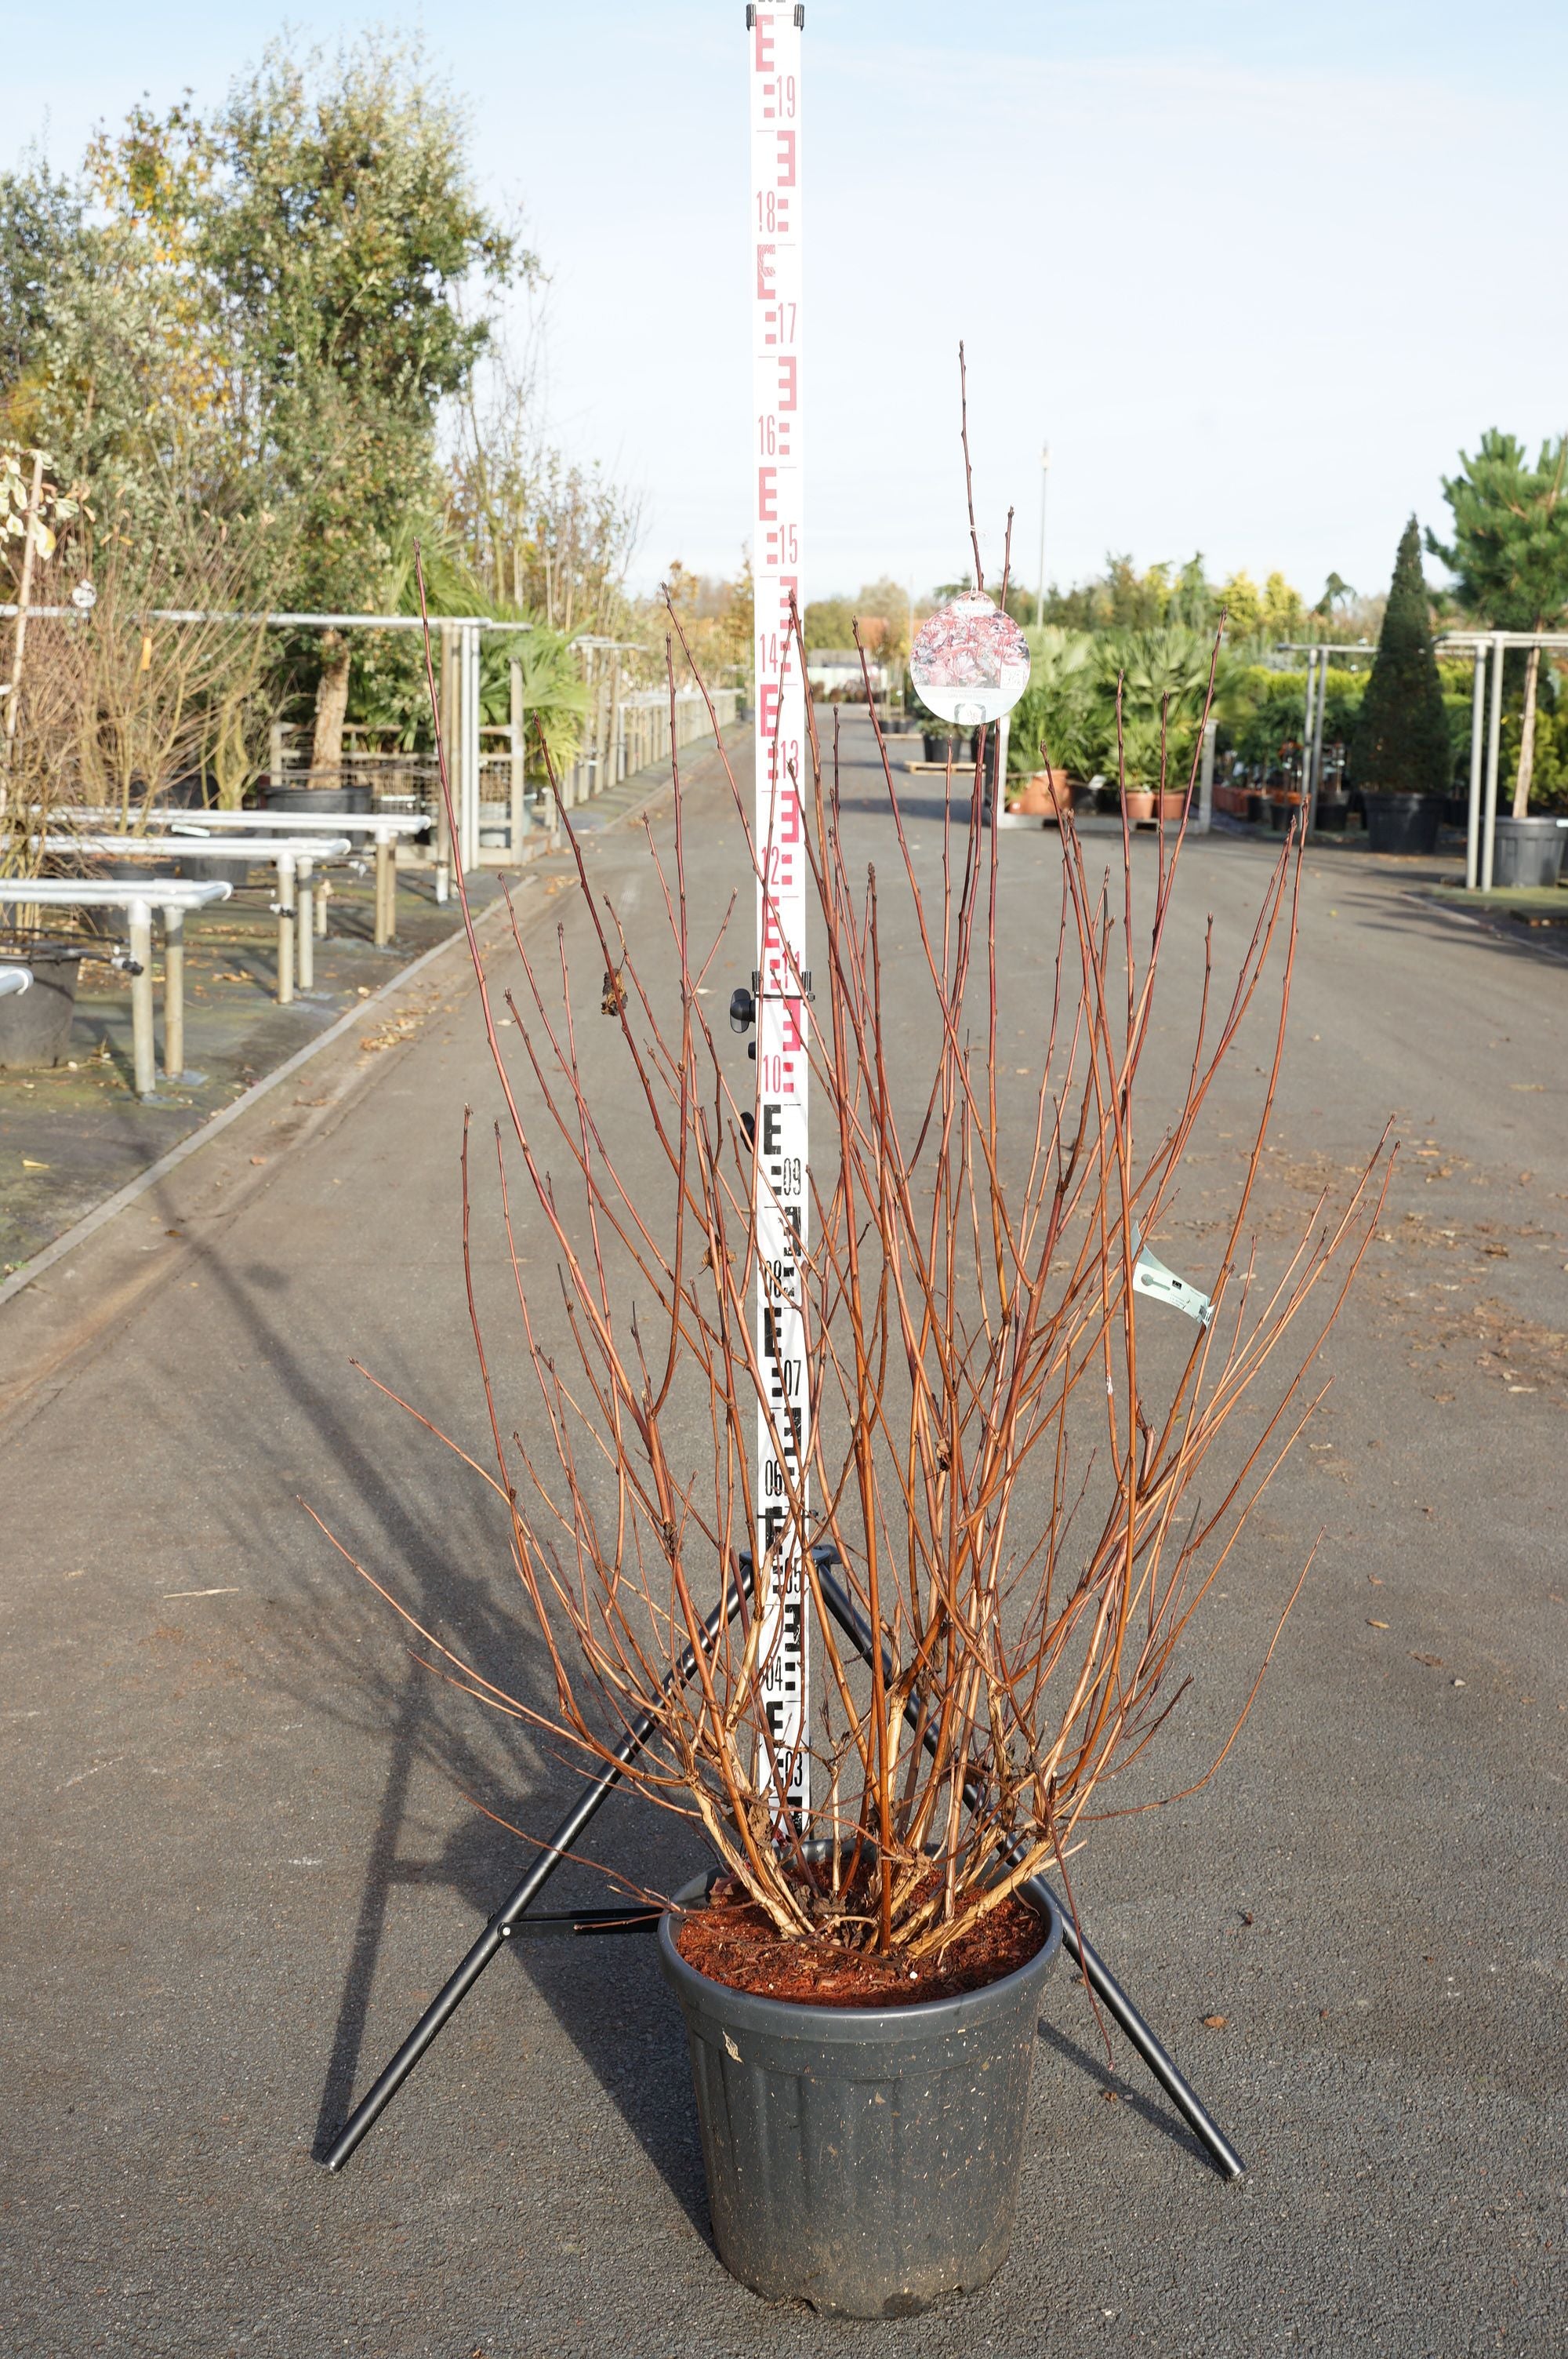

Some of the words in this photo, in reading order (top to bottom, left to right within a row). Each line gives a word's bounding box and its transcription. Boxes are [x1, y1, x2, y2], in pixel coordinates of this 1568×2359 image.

[777, 75, 796, 118] 19
[757, 191, 775, 233] 18
[778, 303, 797, 343] 17
[758, 415, 775, 456] 16
[779, 524, 798, 565] 15
[760, 633, 778, 673] 14
[781, 740, 799, 779] 13
[761, 846, 779, 885] 12
[763, 1055, 781, 1093] 10
[783, 1158, 800, 1195] 09
[764, 1260, 782, 1298] 08
[784, 1359, 801, 1397] 07
[765, 1459, 782, 1496] 06
[766, 1656, 782, 1691] 04
[785, 1751, 803, 1787] 03
